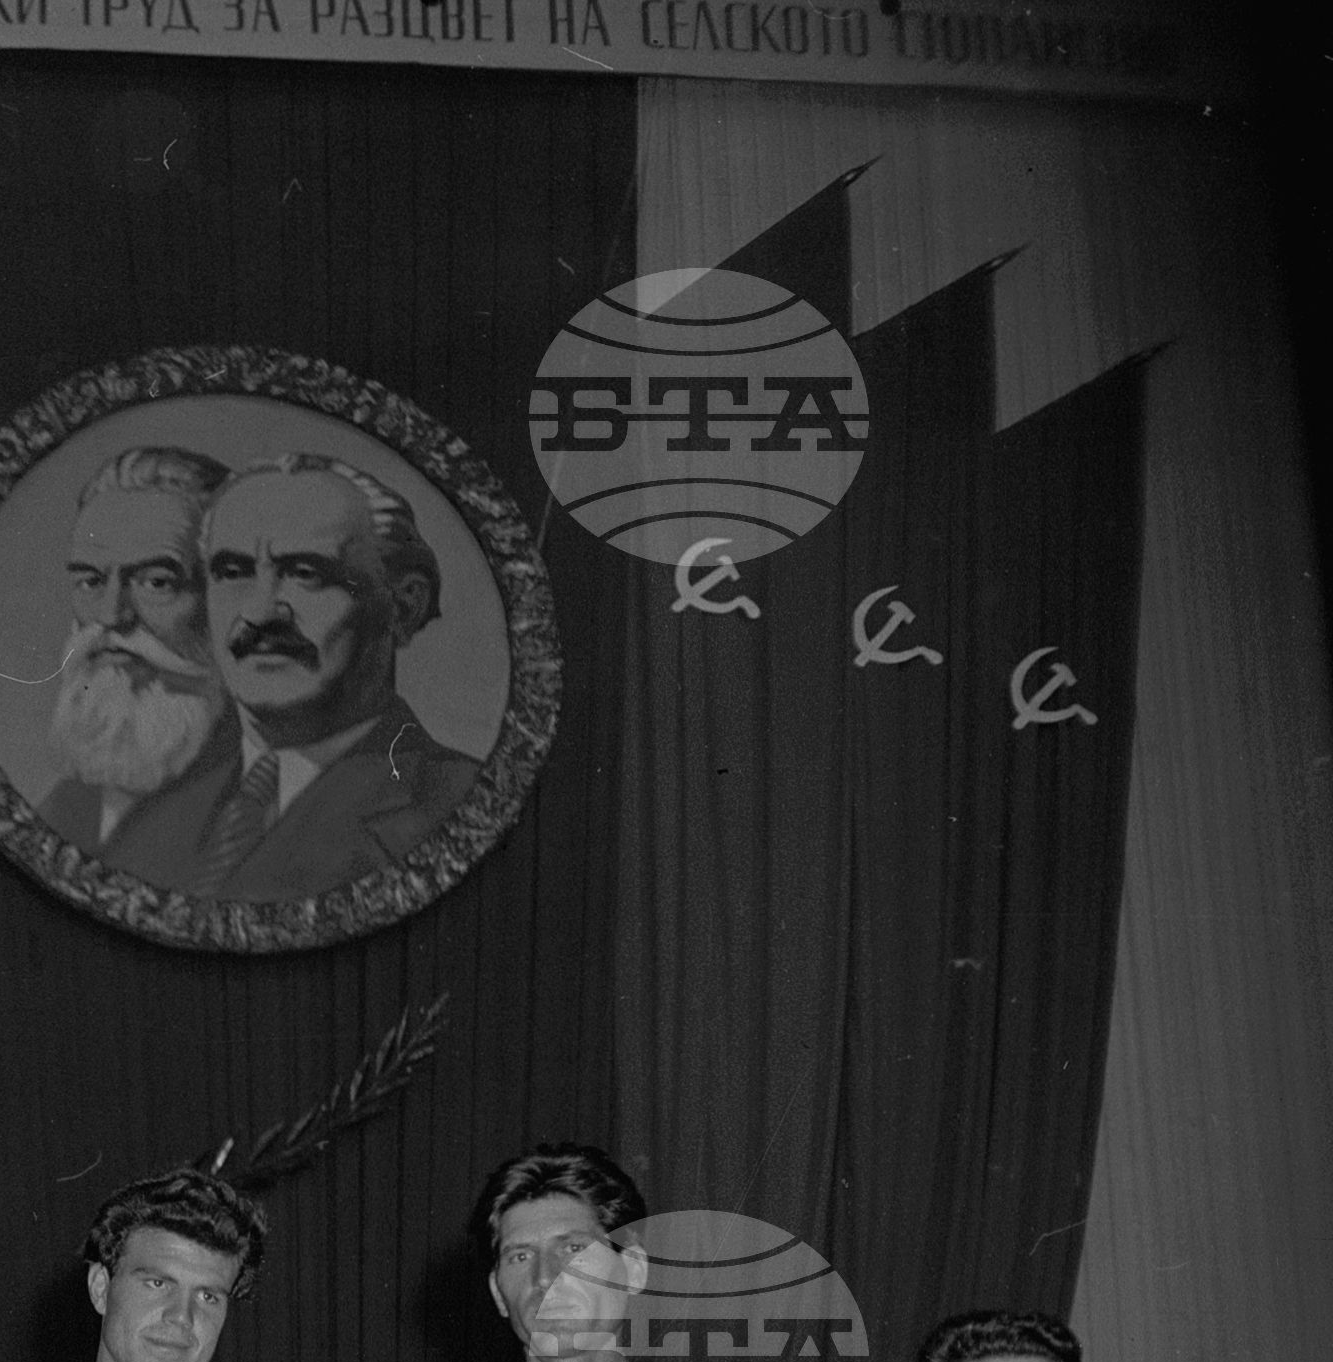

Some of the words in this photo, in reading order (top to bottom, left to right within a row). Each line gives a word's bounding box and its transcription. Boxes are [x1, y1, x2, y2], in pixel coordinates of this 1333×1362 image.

[224, 0, 282, 33] ЗА
[310, 0, 515, 43] РАЗЦВЕТ
[549, 0, 612, 47] НА
[641, 0, 871, 58] СЕЛСКОТО
